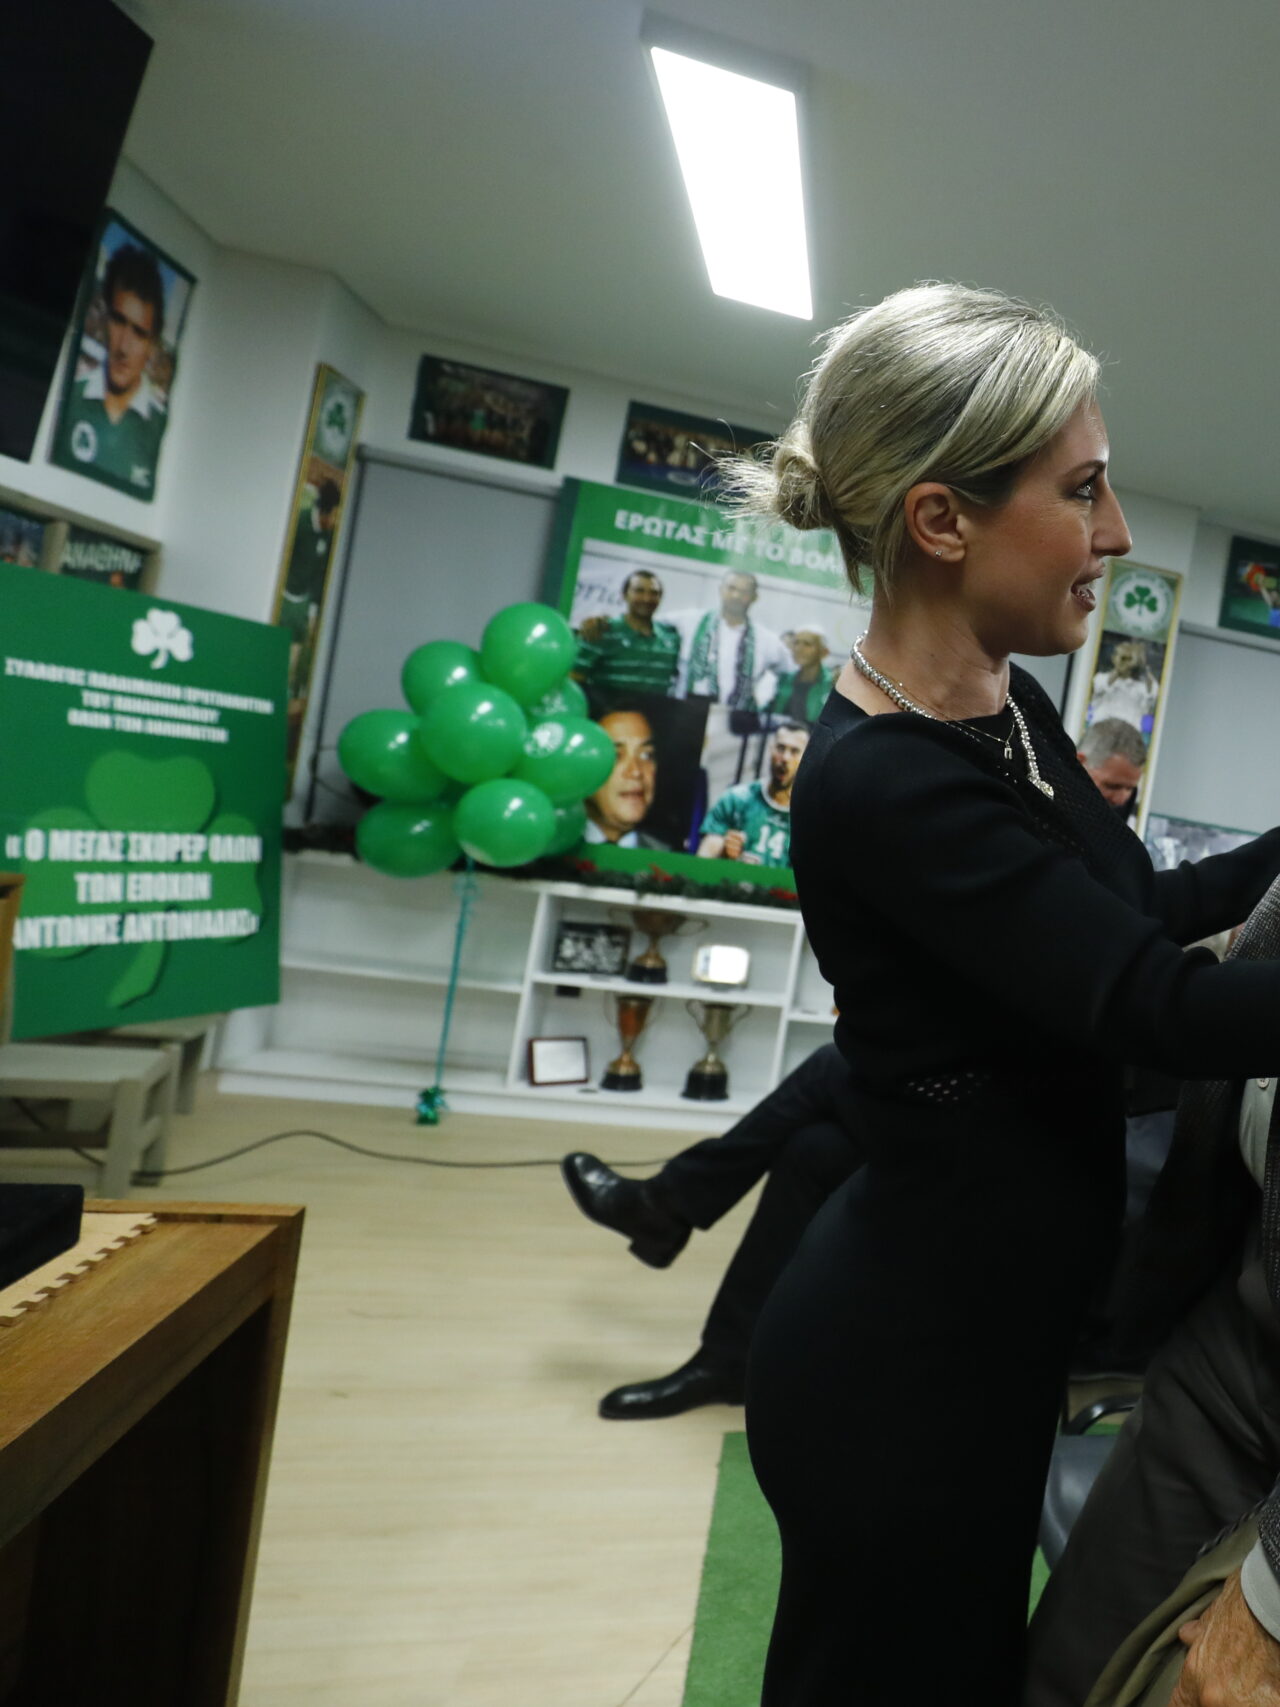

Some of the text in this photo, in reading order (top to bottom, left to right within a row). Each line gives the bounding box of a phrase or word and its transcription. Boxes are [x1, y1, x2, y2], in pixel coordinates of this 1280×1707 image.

[614, 510, 707, 547] ΕΡΩΤΑΣ
[710, 529, 745, 554] ΜΕ
[788, 546, 844, 575] ΒΟΛ
[49, 829, 126, 862] ΜΕΓΑΣ
[127, 832, 208, 863] ΣΚΟΡΕΡ
[208, 834, 263, 863] ΟΛΩΝ
[752, 825, 786, 860] 14
[74, 871, 212, 904] ΤΩΝ ΕΠΟΧΩΝ
